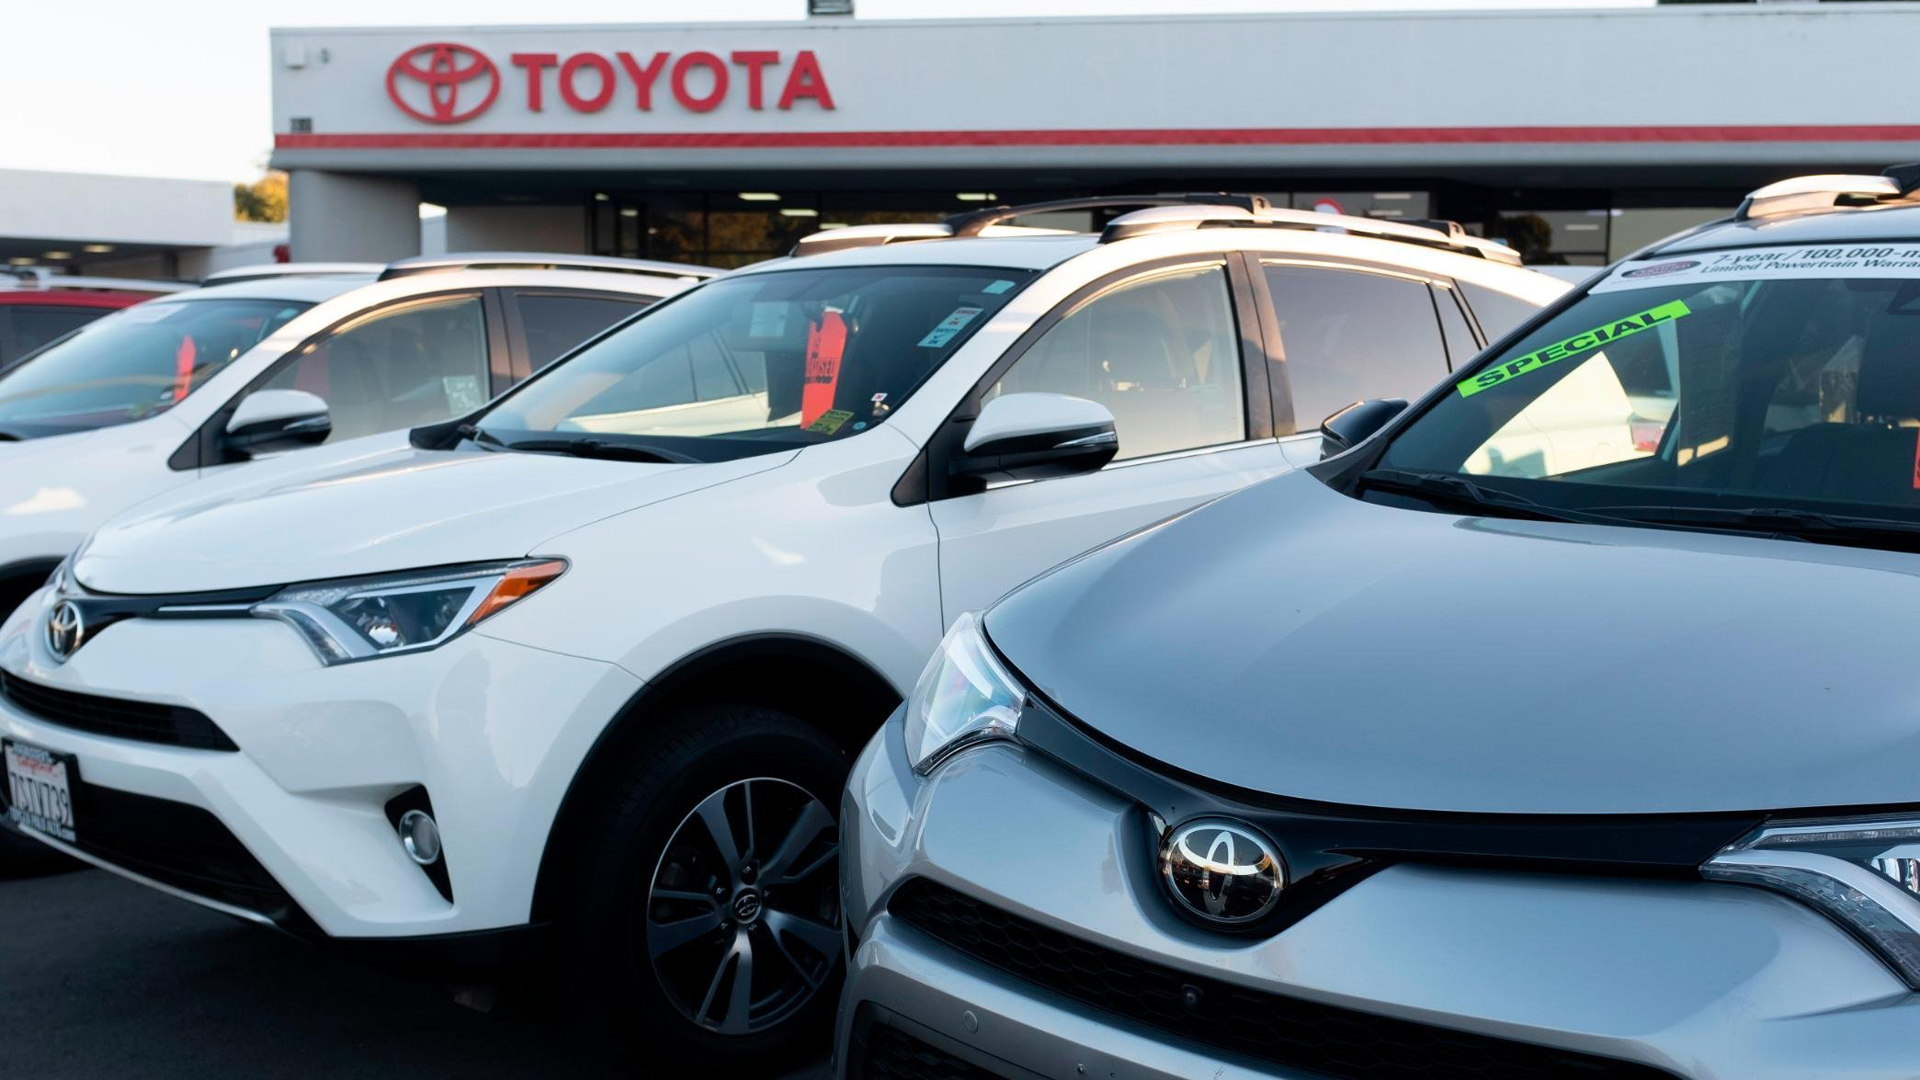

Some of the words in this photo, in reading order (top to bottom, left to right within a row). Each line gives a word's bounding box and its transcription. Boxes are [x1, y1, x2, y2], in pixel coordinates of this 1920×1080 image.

[511, 50, 836, 113] TOYOTA
[1700, 262, 1763, 274] Limited
[1763, 260, 1858, 270] Powertrain
[1863, 259, 1920, 268] Warra
[1476, 312, 1672, 388] SPECIAL
